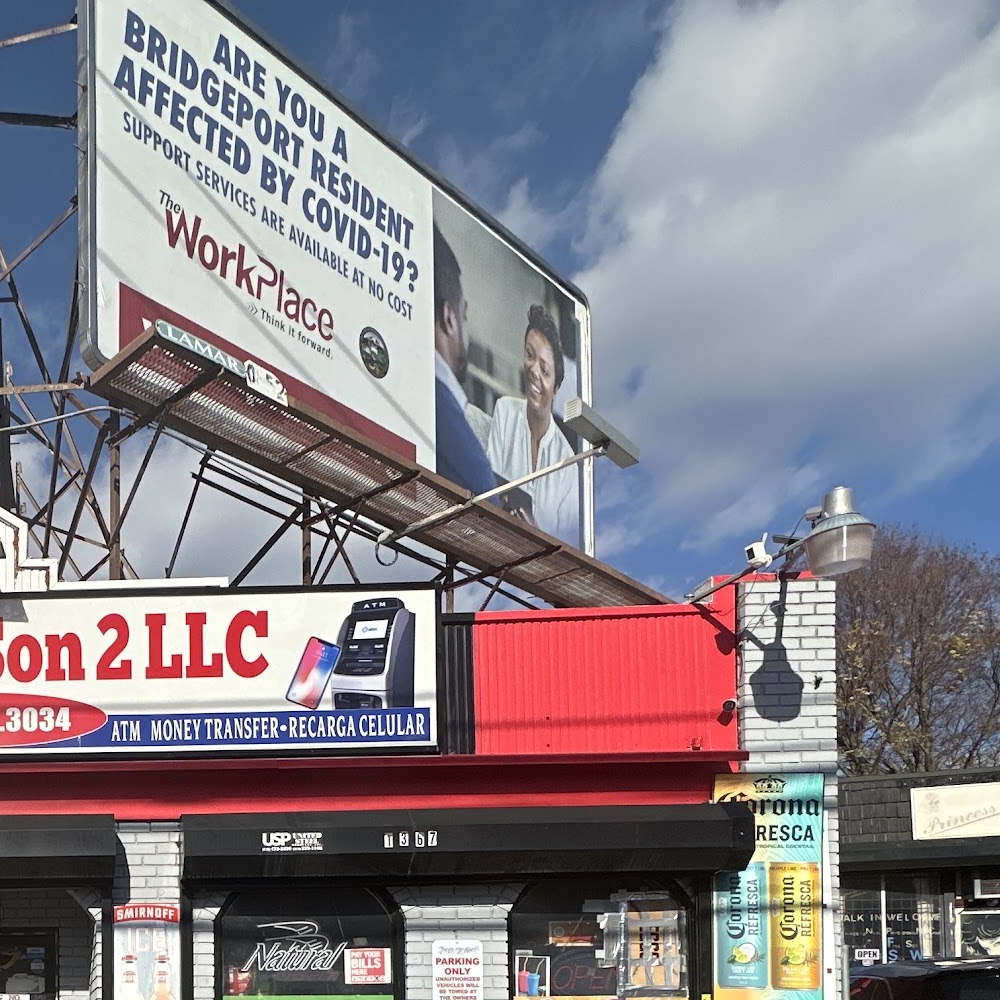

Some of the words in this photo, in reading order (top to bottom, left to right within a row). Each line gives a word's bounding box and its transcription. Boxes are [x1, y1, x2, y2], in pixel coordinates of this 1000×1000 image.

[213, 33, 267, 99] ARE
[275, 76, 325, 142] YOU
[332, 126, 348, 164] A
[124, 8, 304, 169] BRIDGEPORT
[311, 148, 414, 250] RESIDENT
[113, 55, 251, 175] AFFECTED
[260, 155, 295, 205] BY
[302, 188, 419, 293] COVID-19?
[123, 111, 191, 172] SUPPORT
[196, 160, 256, 217] SERVICES
[261, 205, 285, 236] ARE
[289, 224, 349, 279] AVAILABLE
[352, 267, 365, 289] AT
[368, 277, 384, 302] NO
[387, 291, 413, 321] COST
[159, 189, 181, 214] The
[165, 208, 334, 341] WorkPlace
[167, 325, 239, 372] LAMAR
[261, 308, 285, 332] Think
[288, 325, 295, 337] it
[298, 331, 334, 359] forward.
[363, 601, 386, 609] ATM
[96, 613, 132, 680] 2
[144, 609, 269, 679] LLC
[111, 719, 141, 742] ATM
[150, 718, 201, 741] MONEY
[358, 713, 425, 737] CELULAR
[262, 832, 291, 846] USP
[116, 906, 175, 920] SMIRNOFF
[726, 875, 747, 939] Corona
[747, 879, 759, 936] REFRESCA
[779, 875, 800, 940] Corona
[800, 879, 812, 937] REFRESCA
[127, 928, 167, 952] ICE
[242, 942, 348, 971] Natural
[351, 957, 381, 969] BILLS
[857, 950, 878, 958] OPEN
